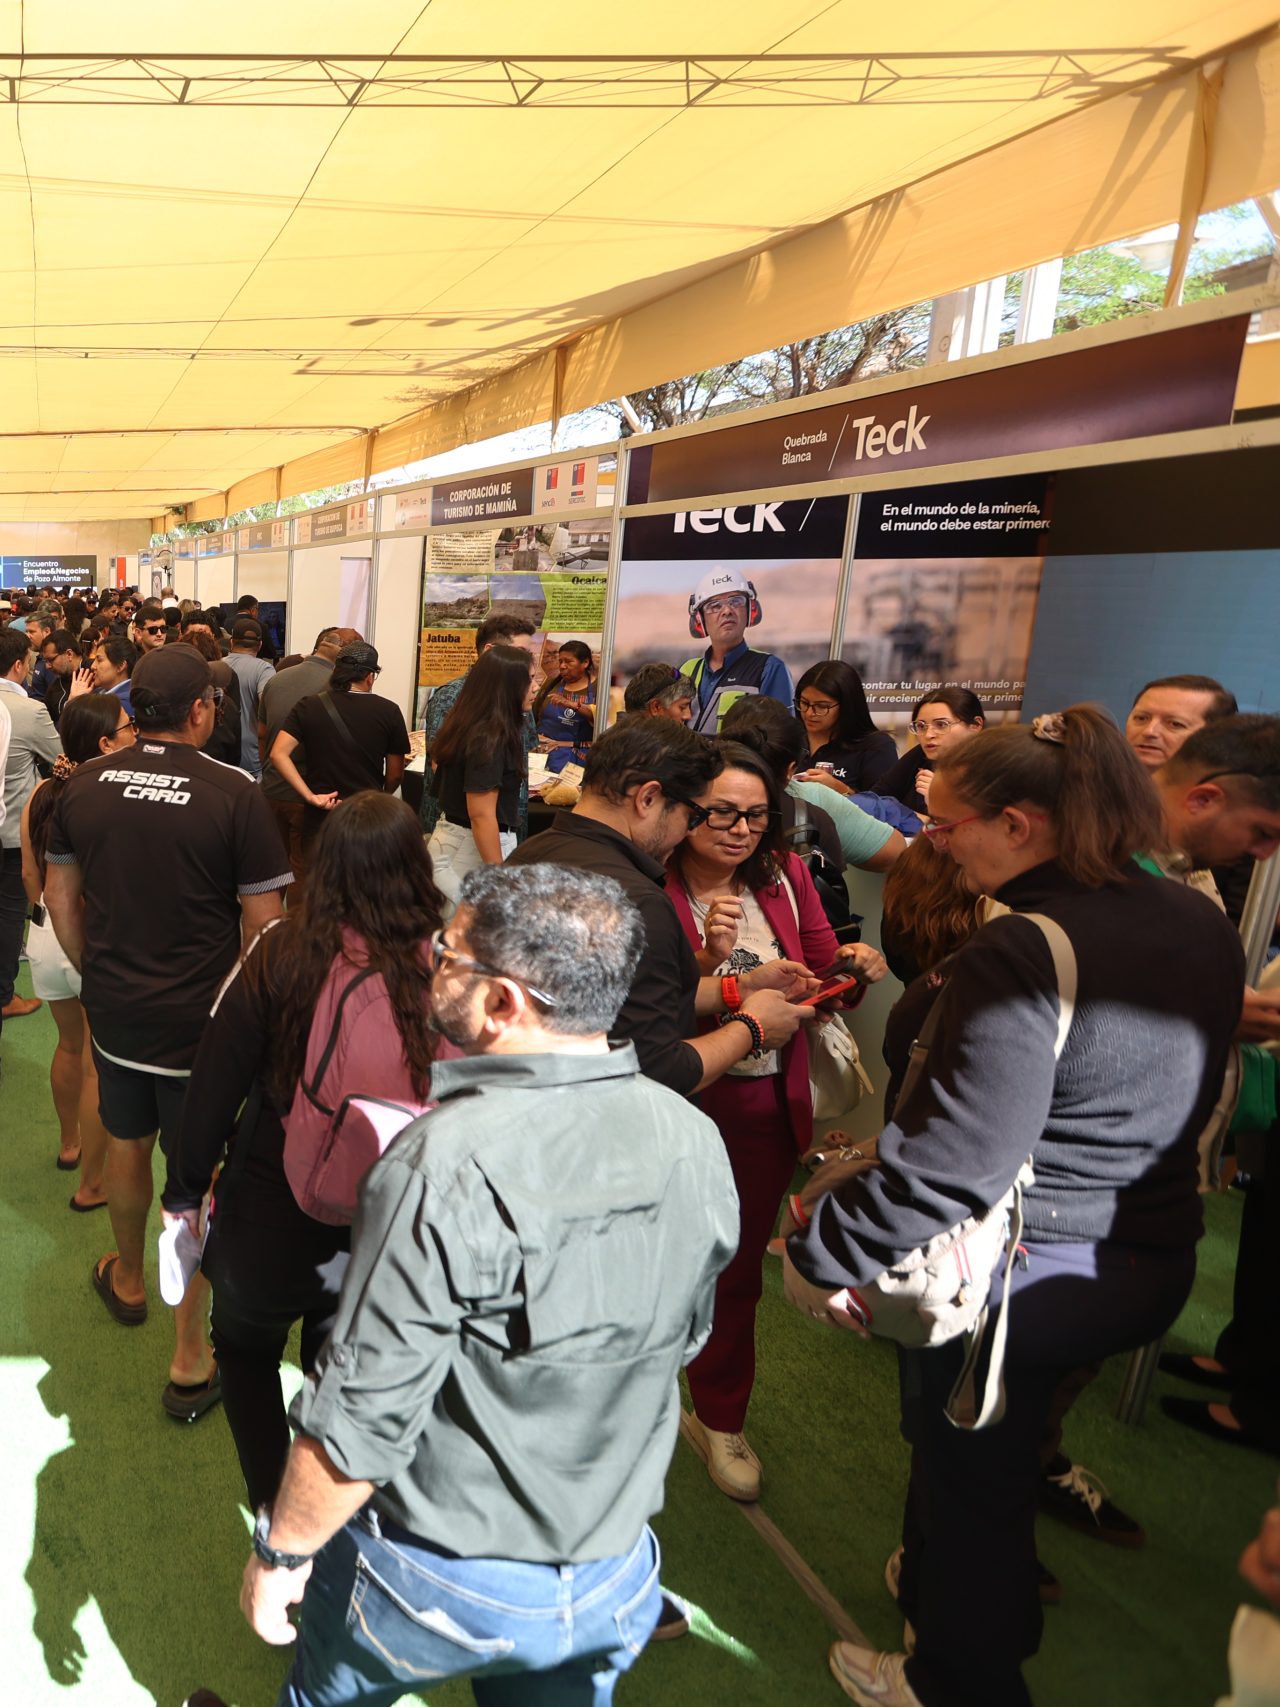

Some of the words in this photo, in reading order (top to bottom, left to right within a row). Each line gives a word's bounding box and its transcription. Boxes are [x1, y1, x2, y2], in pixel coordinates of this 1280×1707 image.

[852, 404, 931, 461] Teck
[784, 430, 827, 450] Quebrada
[782, 452, 811, 465] Blanca
[449, 483, 498, 503] CORPORACIÓN
[500, 482, 512, 495] DE
[444, 505, 473, 519] TURISMO
[475, 504, 485, 516] DE
[485, 498, 517, 514] MAMIÑA
[883, 503, 899, 516] En
[901, 503, 912, 516] el
[914, 502, 958, 516] mundo
[960, 502, 976, 515] de
[978, 502, 990, 515] la
[991, 501, 1041, 515] minería,
[880, 519, 892, 532] el
[894, 519, 937, 531] mundo
[939, 518, 971, 531] debe
[972, 518, 1005, 530] estar
[23, 560, 59, 568] Encuentro
[23, 567, 90, 576] Empleo&Negocios
[23, 575, 33, 583] de
[427, 633, 461, 643] Jatuba
[861, 680, 898, 690] contrar
[900, 681, 912, 690] tu
[914, 680, 942, 692] lugar
[961, 680, 971, 689] el
[974, 680, 1010, 689] mundo
[1012, 681, 1026, 690] pa
[879, 693, 925, 703] creciend
[993, 692, 1024, 704] prime
[98, 770, 190, 789] ASSIST
[123, 785, 191, 805] CARD
